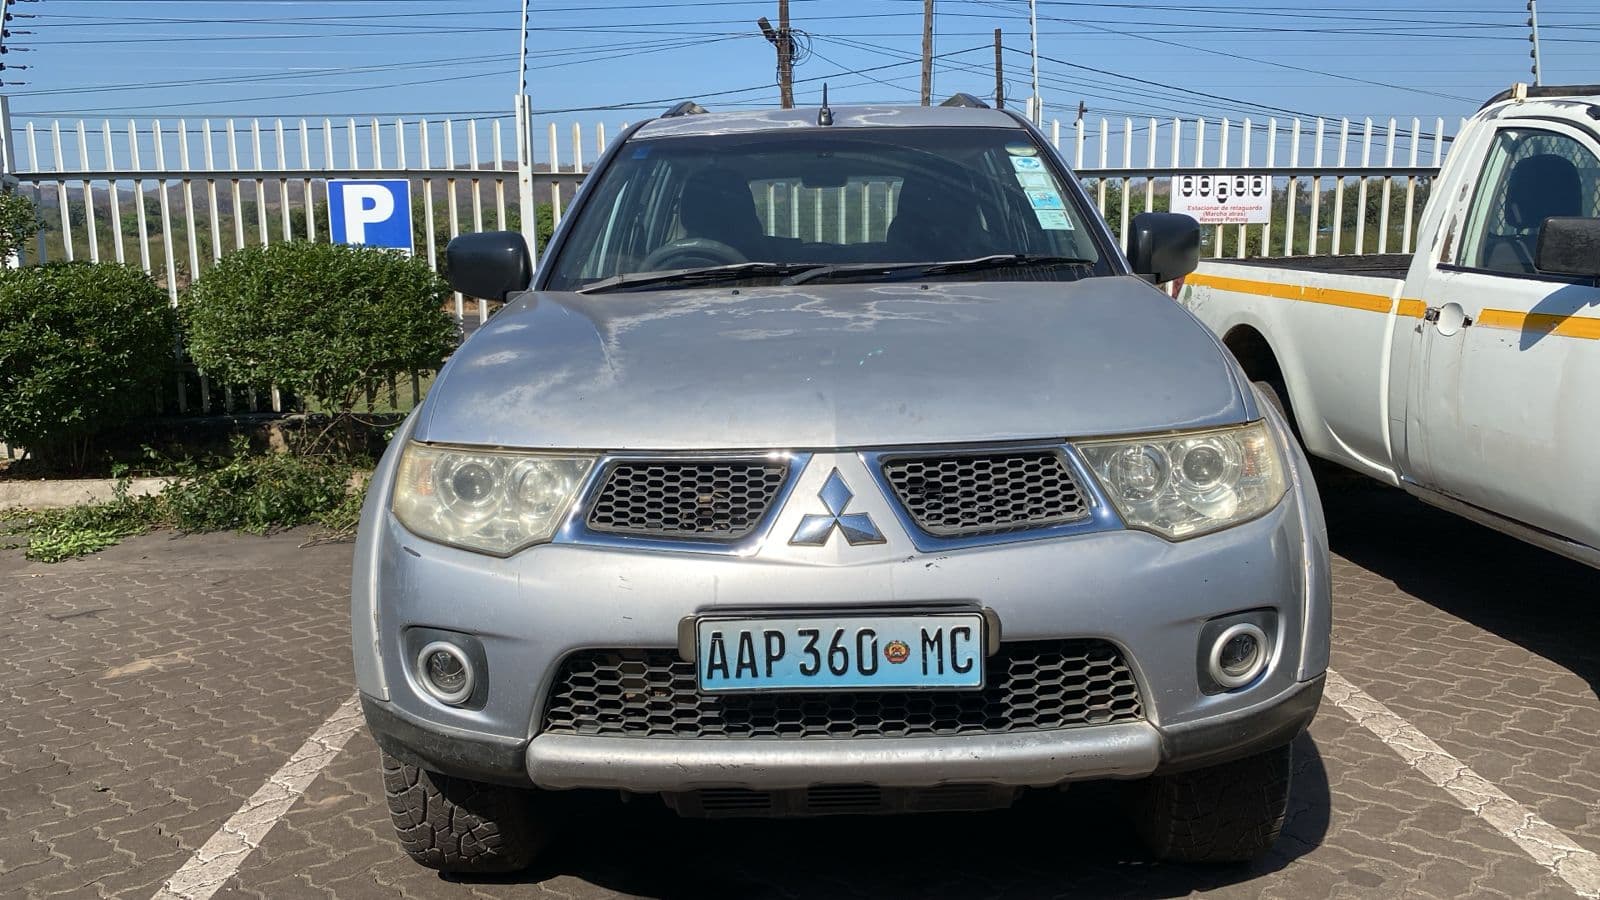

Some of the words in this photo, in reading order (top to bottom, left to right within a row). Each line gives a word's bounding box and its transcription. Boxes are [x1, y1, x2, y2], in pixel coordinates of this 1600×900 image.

[342, 184, 394, 244] P
[706, 630, 786, 680] AAP
[797, 626, 878, 676] 360
[920, 625, 974, 676] MC
